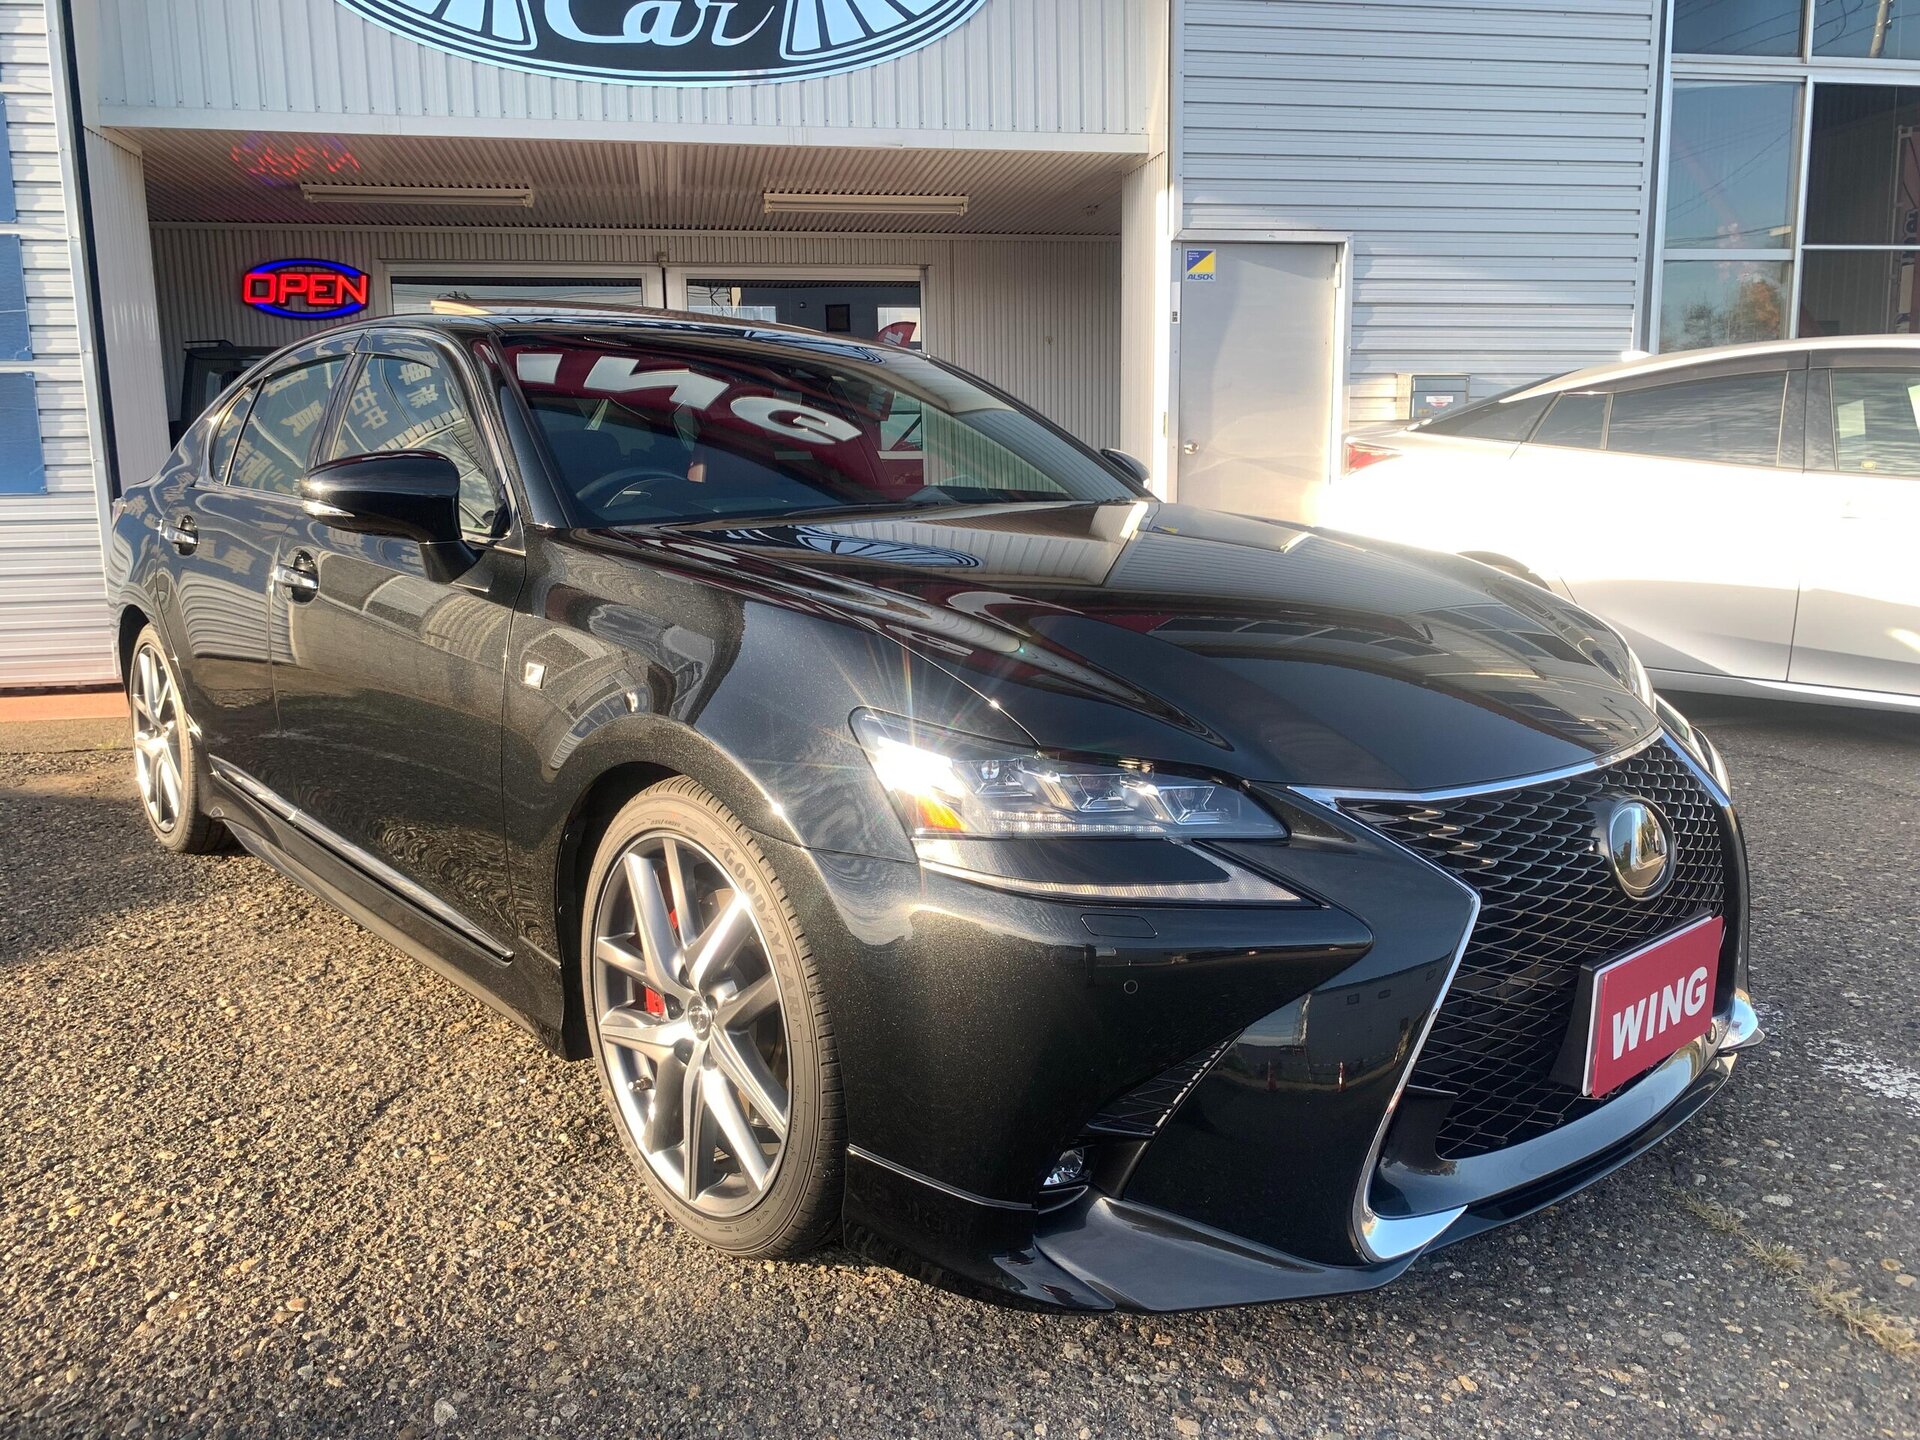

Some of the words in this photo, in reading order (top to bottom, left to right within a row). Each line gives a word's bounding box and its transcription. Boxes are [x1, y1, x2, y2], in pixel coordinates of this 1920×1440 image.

[244, 273, 367, 304] OPEN
[1187, 273, 1214, 281] ALSOK
[1612, 966, 1708, 1061] WING
